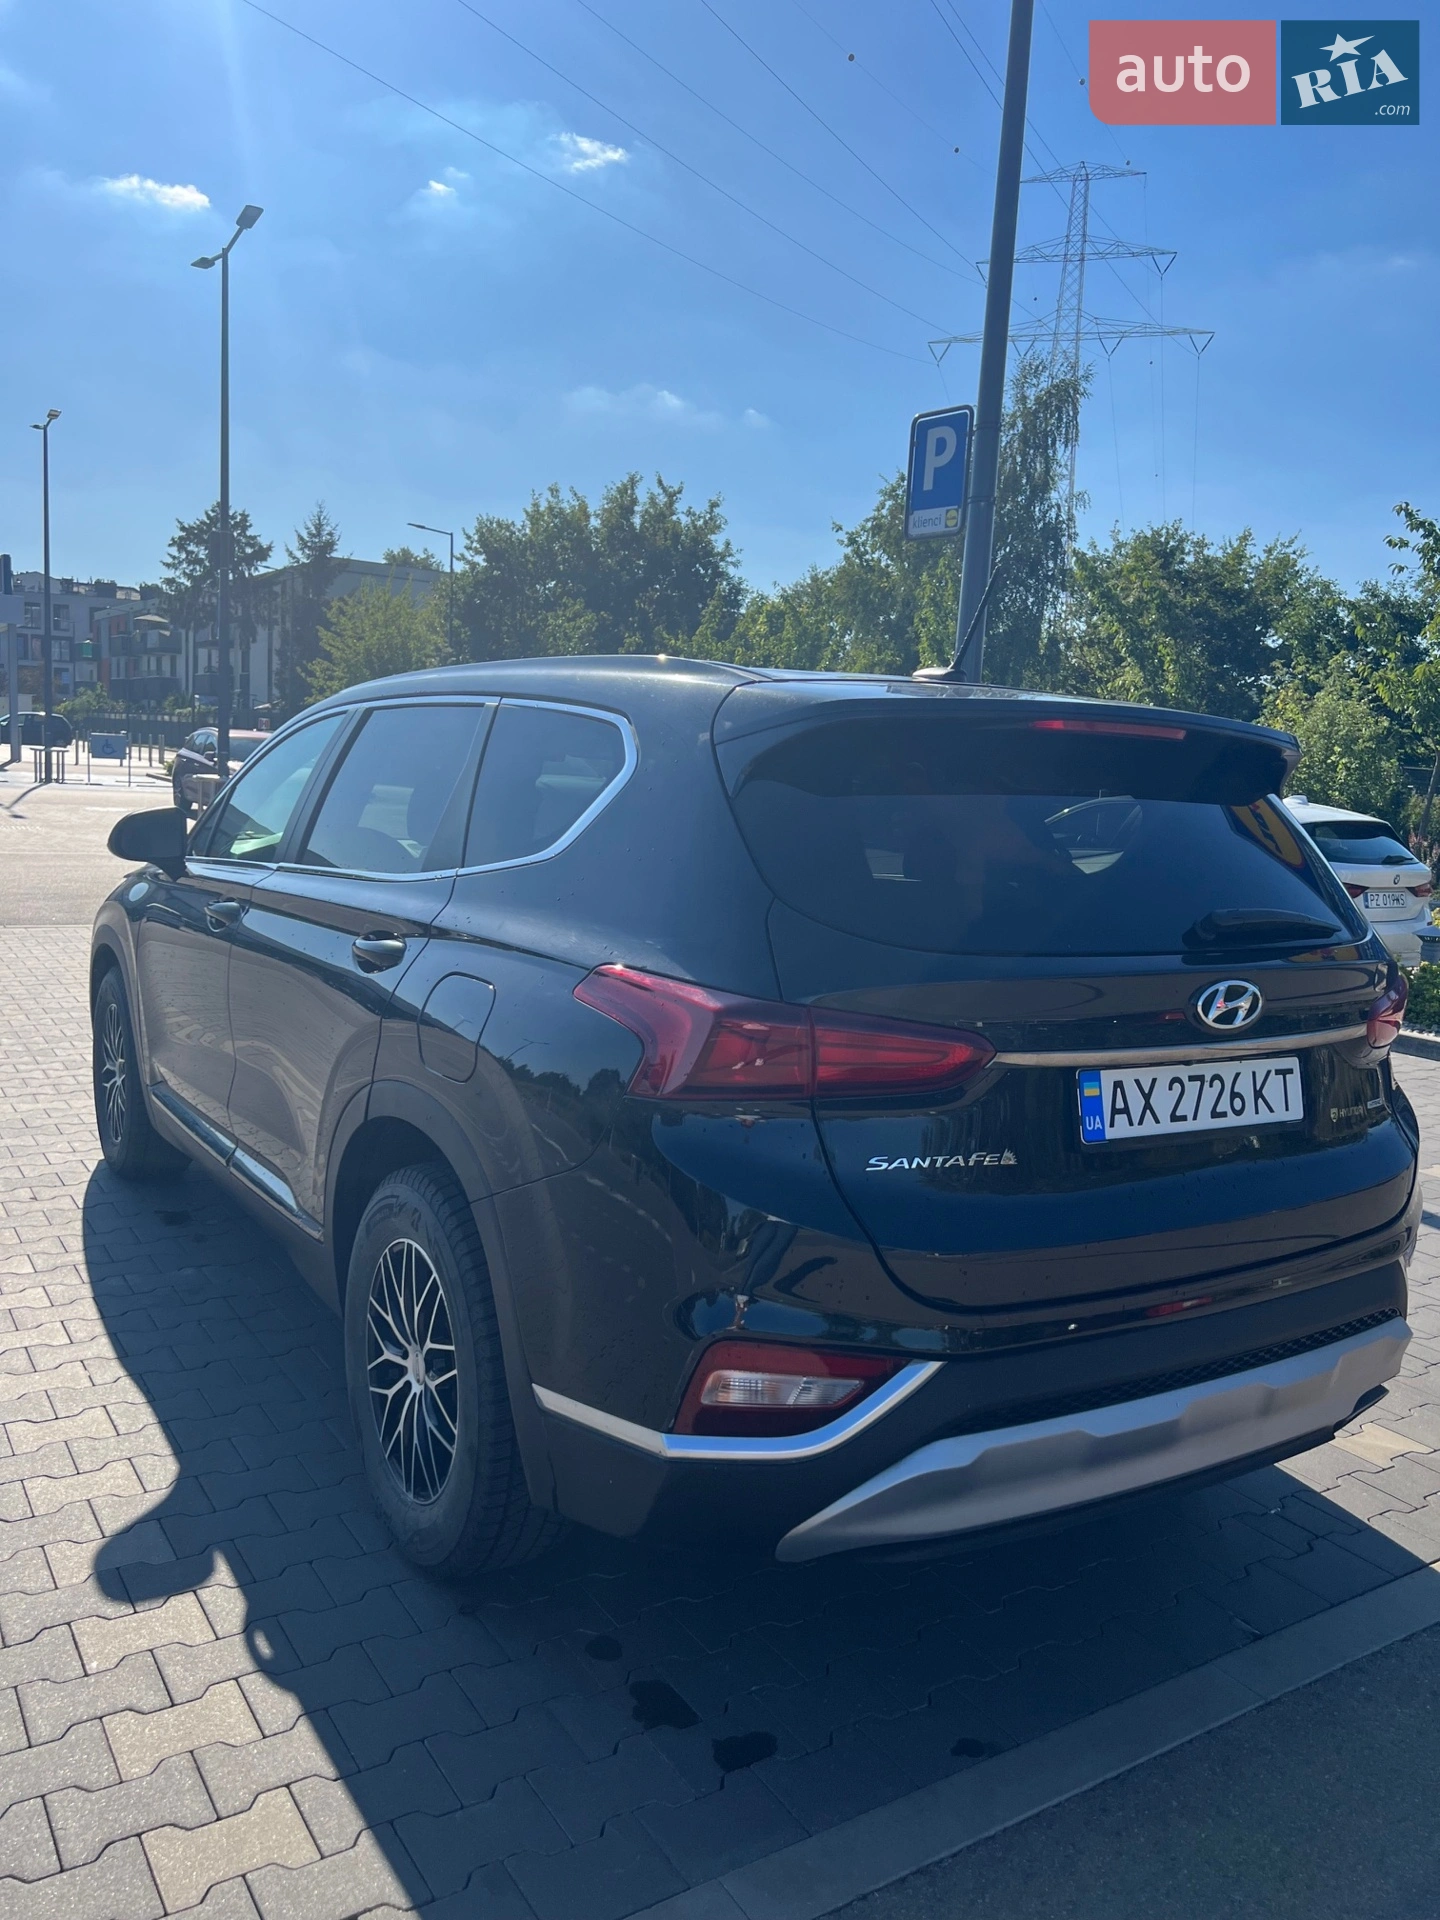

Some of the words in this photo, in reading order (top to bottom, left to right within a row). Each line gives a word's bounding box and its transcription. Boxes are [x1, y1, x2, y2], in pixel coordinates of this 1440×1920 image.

[923, 426, 957, 491] P
[912, 514, 942, 529] klienci
[1369, 893, 1381, 907] PZ
[1109, 1078, 1161, 1128] AX
[1168, 1072, 1246, 1123] 2726
[1252, 1068, 1294, 1115] KT
[1086, 1115, 1103, 1131] UA
